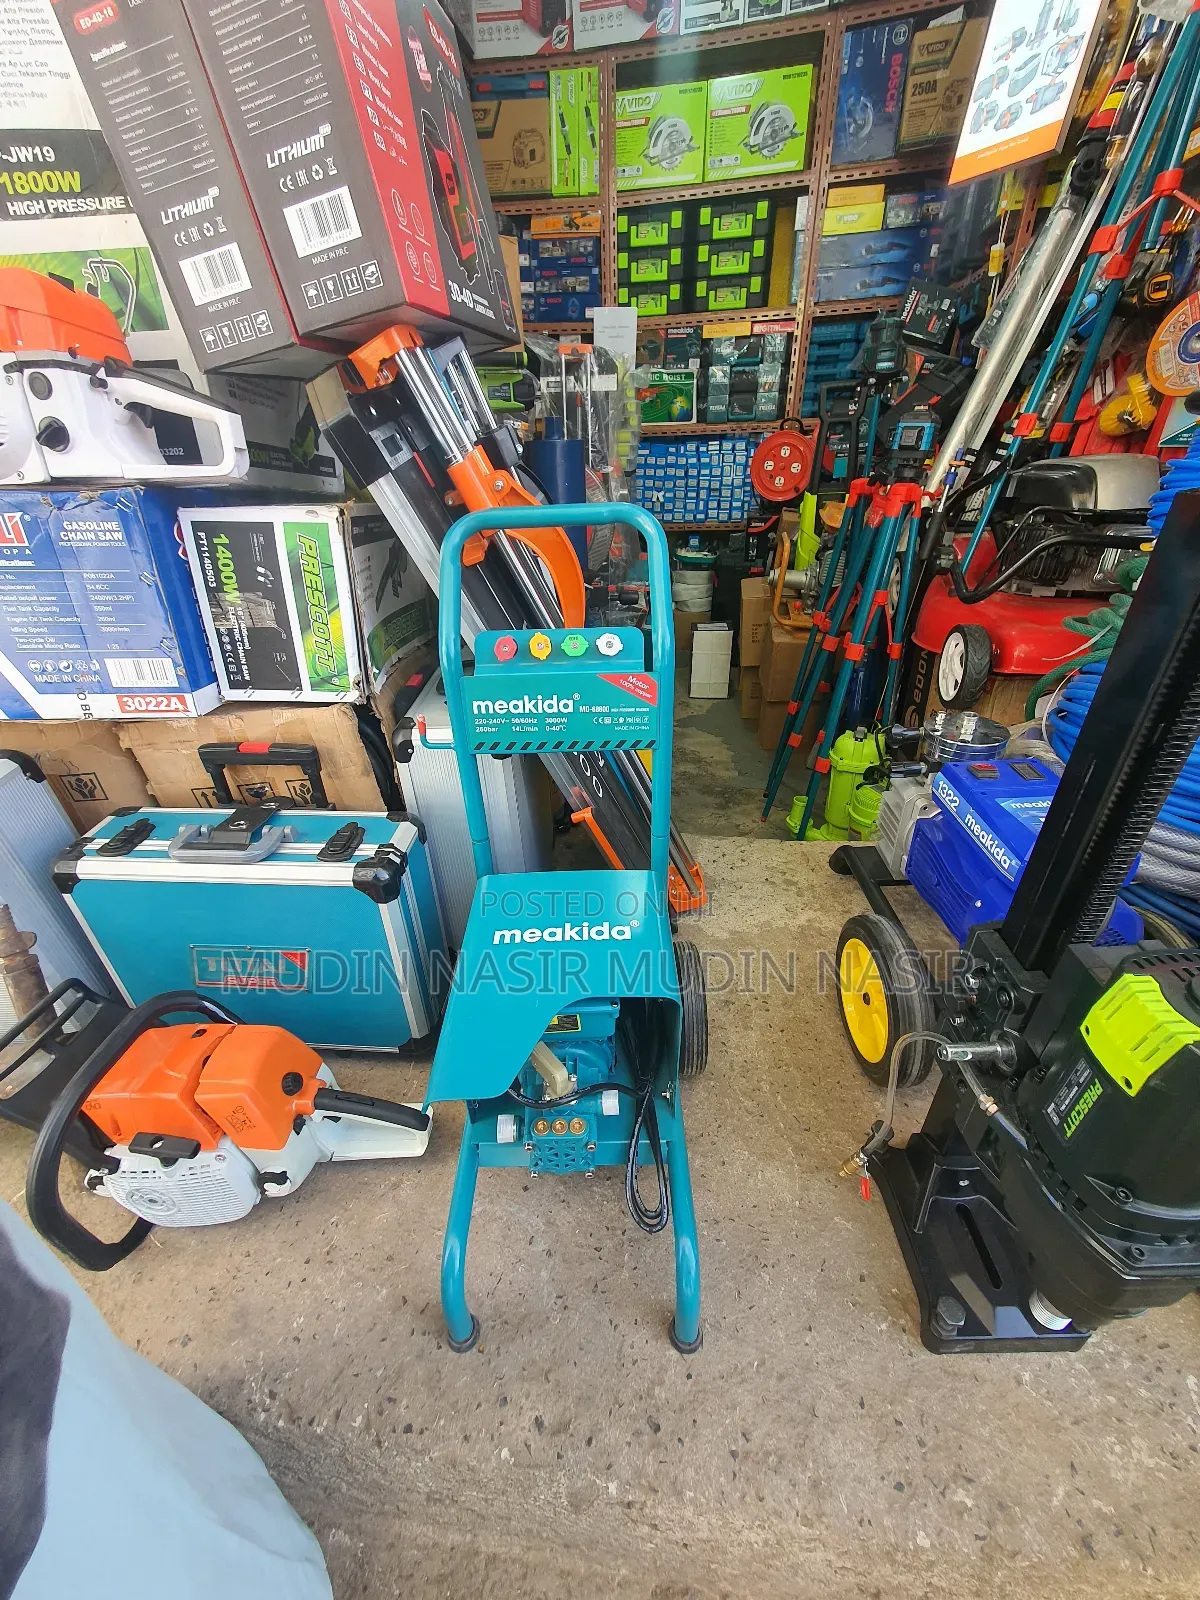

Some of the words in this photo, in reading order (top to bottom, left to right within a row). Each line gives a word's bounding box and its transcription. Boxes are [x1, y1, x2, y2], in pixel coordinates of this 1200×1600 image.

[928, 43, 946, 53] VIDO
[728, 82, 752, 96] VIDO
[885, 53, 903, 113] BOSCH
[911, 80, 938, 98] 250A
[628, 96, 651, 109] VIDO
[0, 170, 81, 195] 1800W
[7, 200, 46, 215] HIGH
[46, 196, 126, 214] PRESSURE
[63, 521, 120, 531] GASOLINE
[60, 532, 95, 541] CHAIN
[99, 532, 123, 541] SAW
[213, 533, 241, 604] 1400W
[33, 605, 60, 613] Capacity
[297, 532, 338, 675] PRESCOTT
[228, 606, 241, 642] ELECTRIC
[236, 641, 247, 665] CHAIN
[34, 674, 61, 682] MADE
[62, 674, 72, 682] IN
[73, 674, 102, 682] CHINA
[241, 664, 251, 681] SAW
[627, 675, 650, 690] Motor
[121, 696, 185, 711] 3022A
[472, 694, 575, 715] meakida
[936, 779, 960, 813] 1322
[963, 812, 1012, 870] meakida
[492, 921, 633, 946] meakida
[202, 956, 294, 975] TOTAL
[225, 975, 277, 987] SUPER
[1063, 1078, 1103, 1141] PRESCOTT
